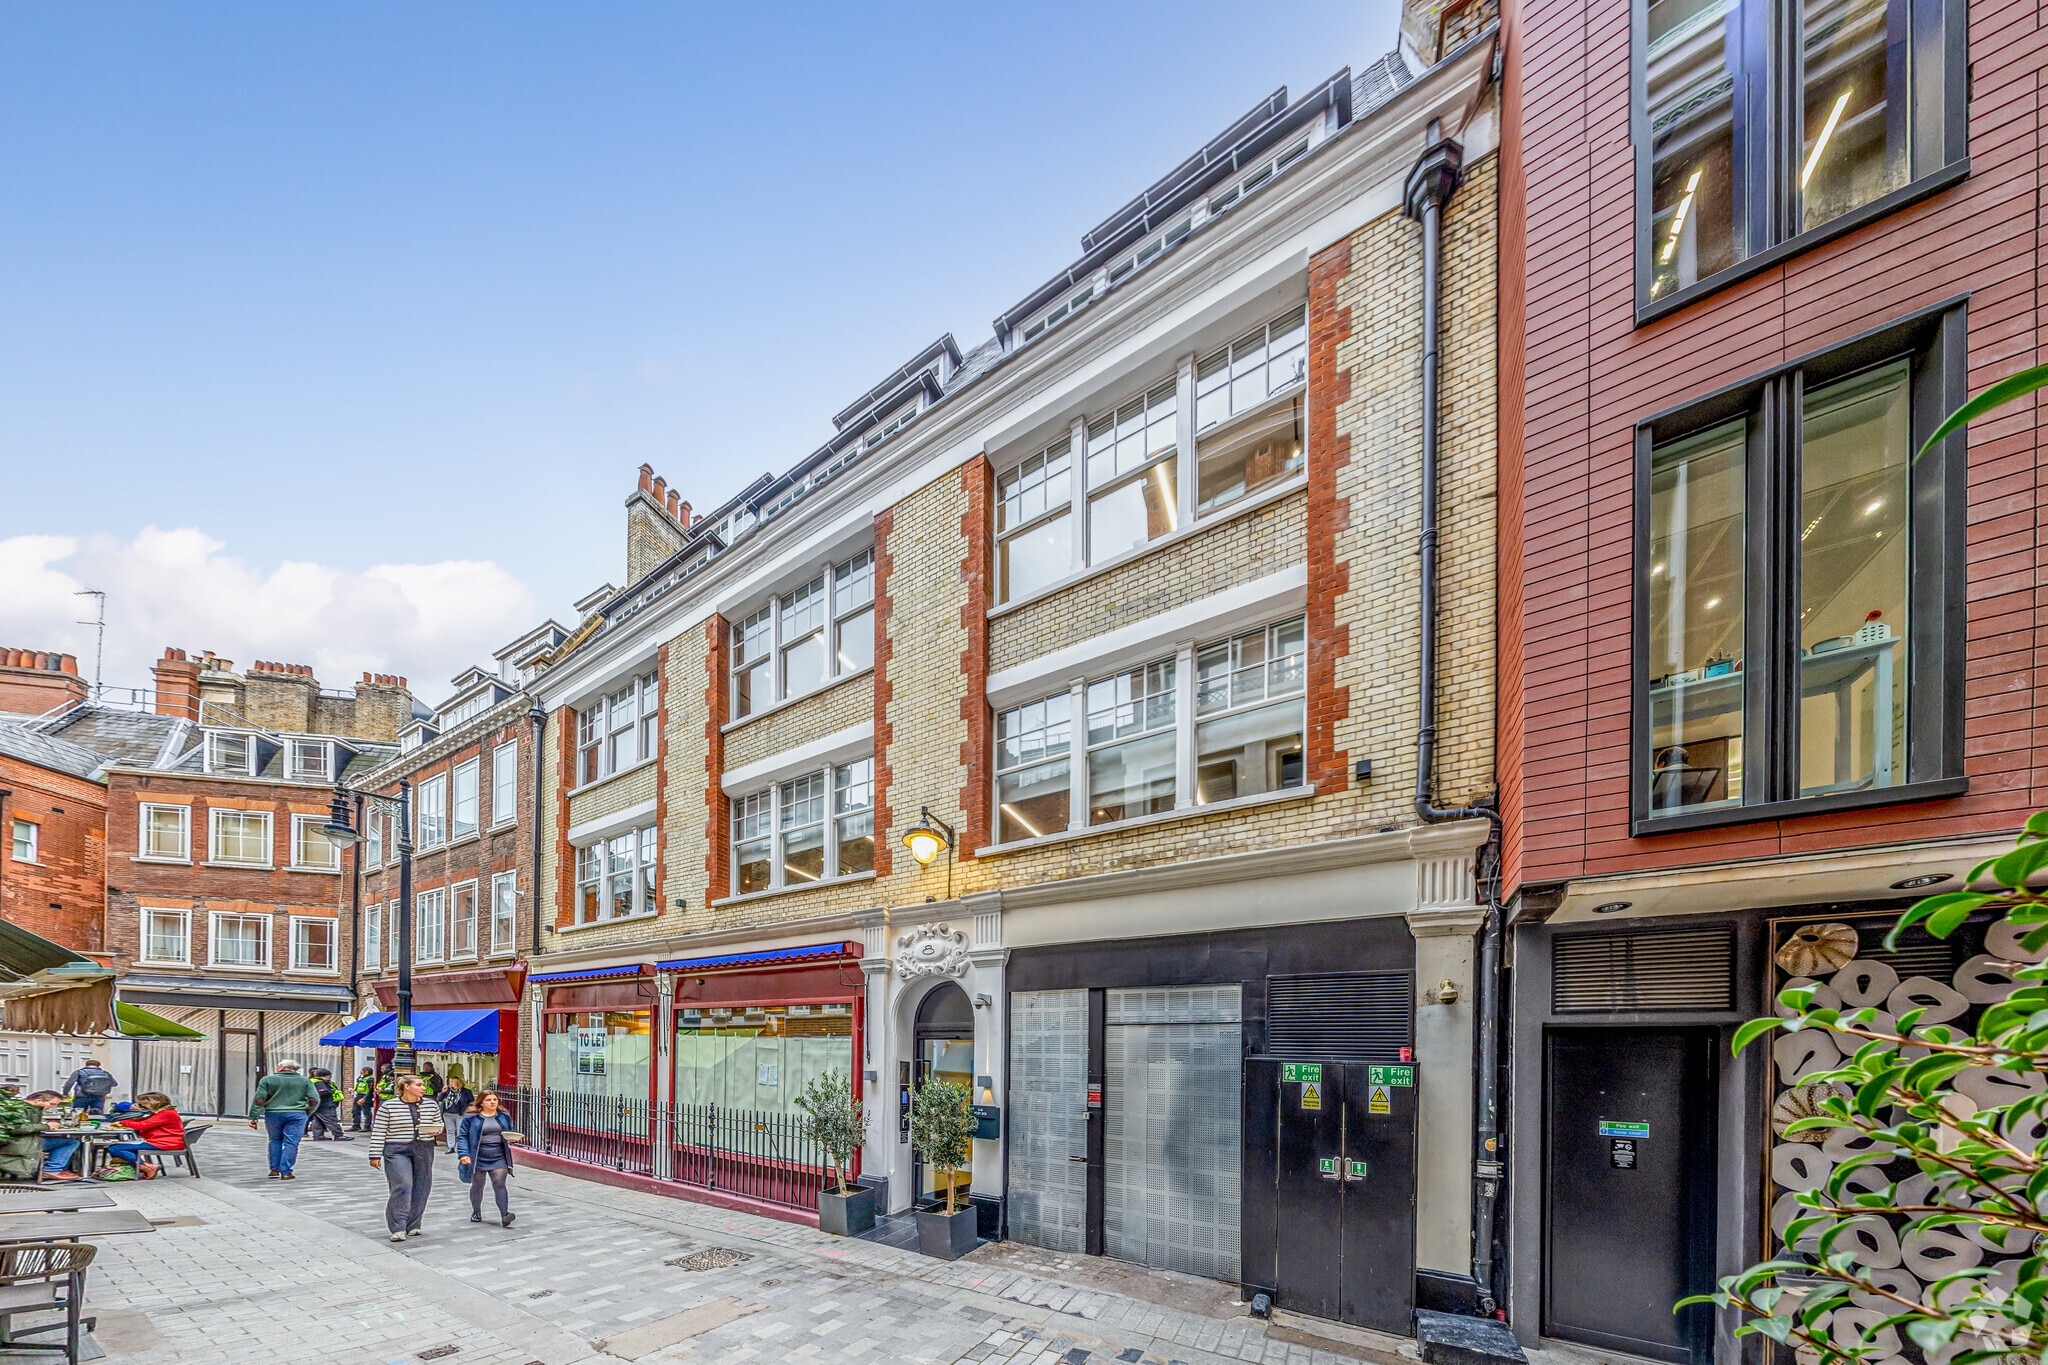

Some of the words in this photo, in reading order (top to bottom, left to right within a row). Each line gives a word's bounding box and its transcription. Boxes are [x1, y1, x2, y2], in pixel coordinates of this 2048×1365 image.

[922, 945, 935, 955] 8
[580, 1033, 590, 1046] TO
[592, 1033, 605, 1047] LET
[1302, 1065, 1320, 1073] Fire
[1390, 1068, 1410, 1076] Fire
